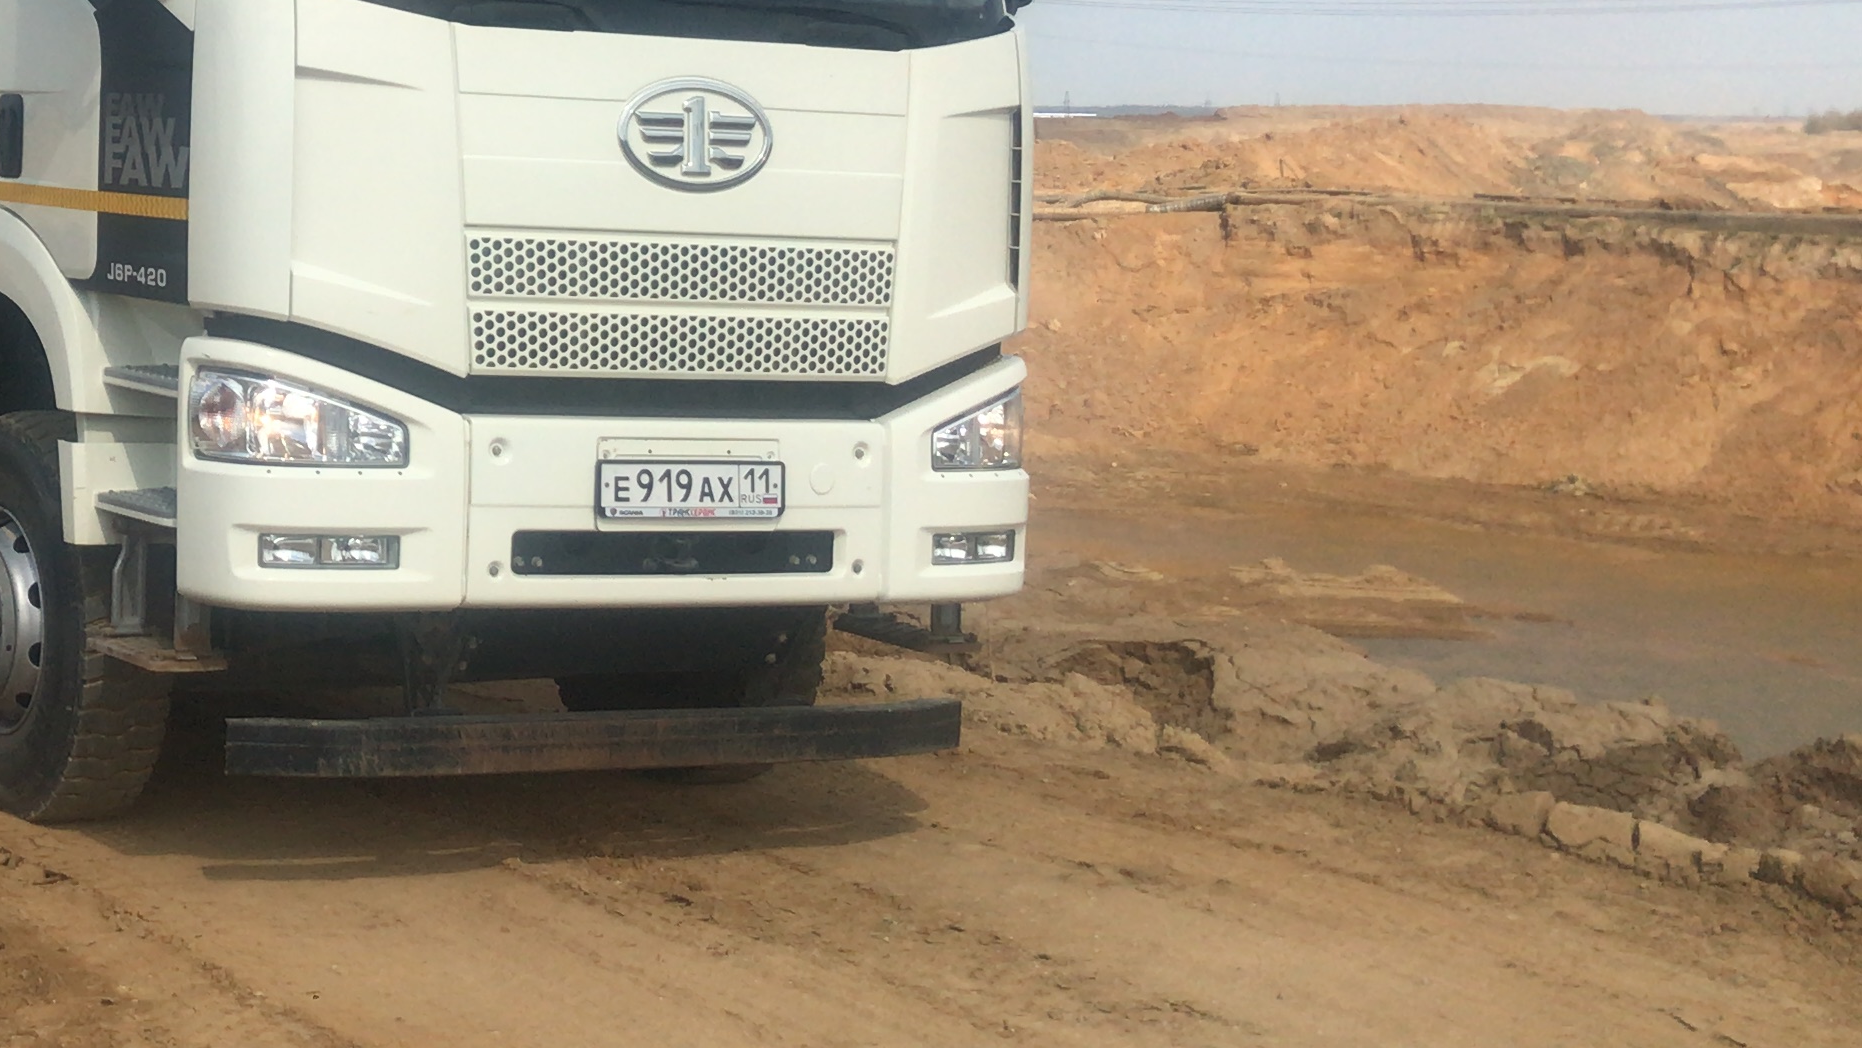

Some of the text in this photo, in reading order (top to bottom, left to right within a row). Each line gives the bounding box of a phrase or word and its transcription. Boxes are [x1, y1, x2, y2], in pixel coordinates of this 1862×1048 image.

[103, 146, 190, 188] FAW
[107, 263, 167, 287] J6P-420
[743, 468, 770, 493] 11
[740, 493, 762, 503] RUS
